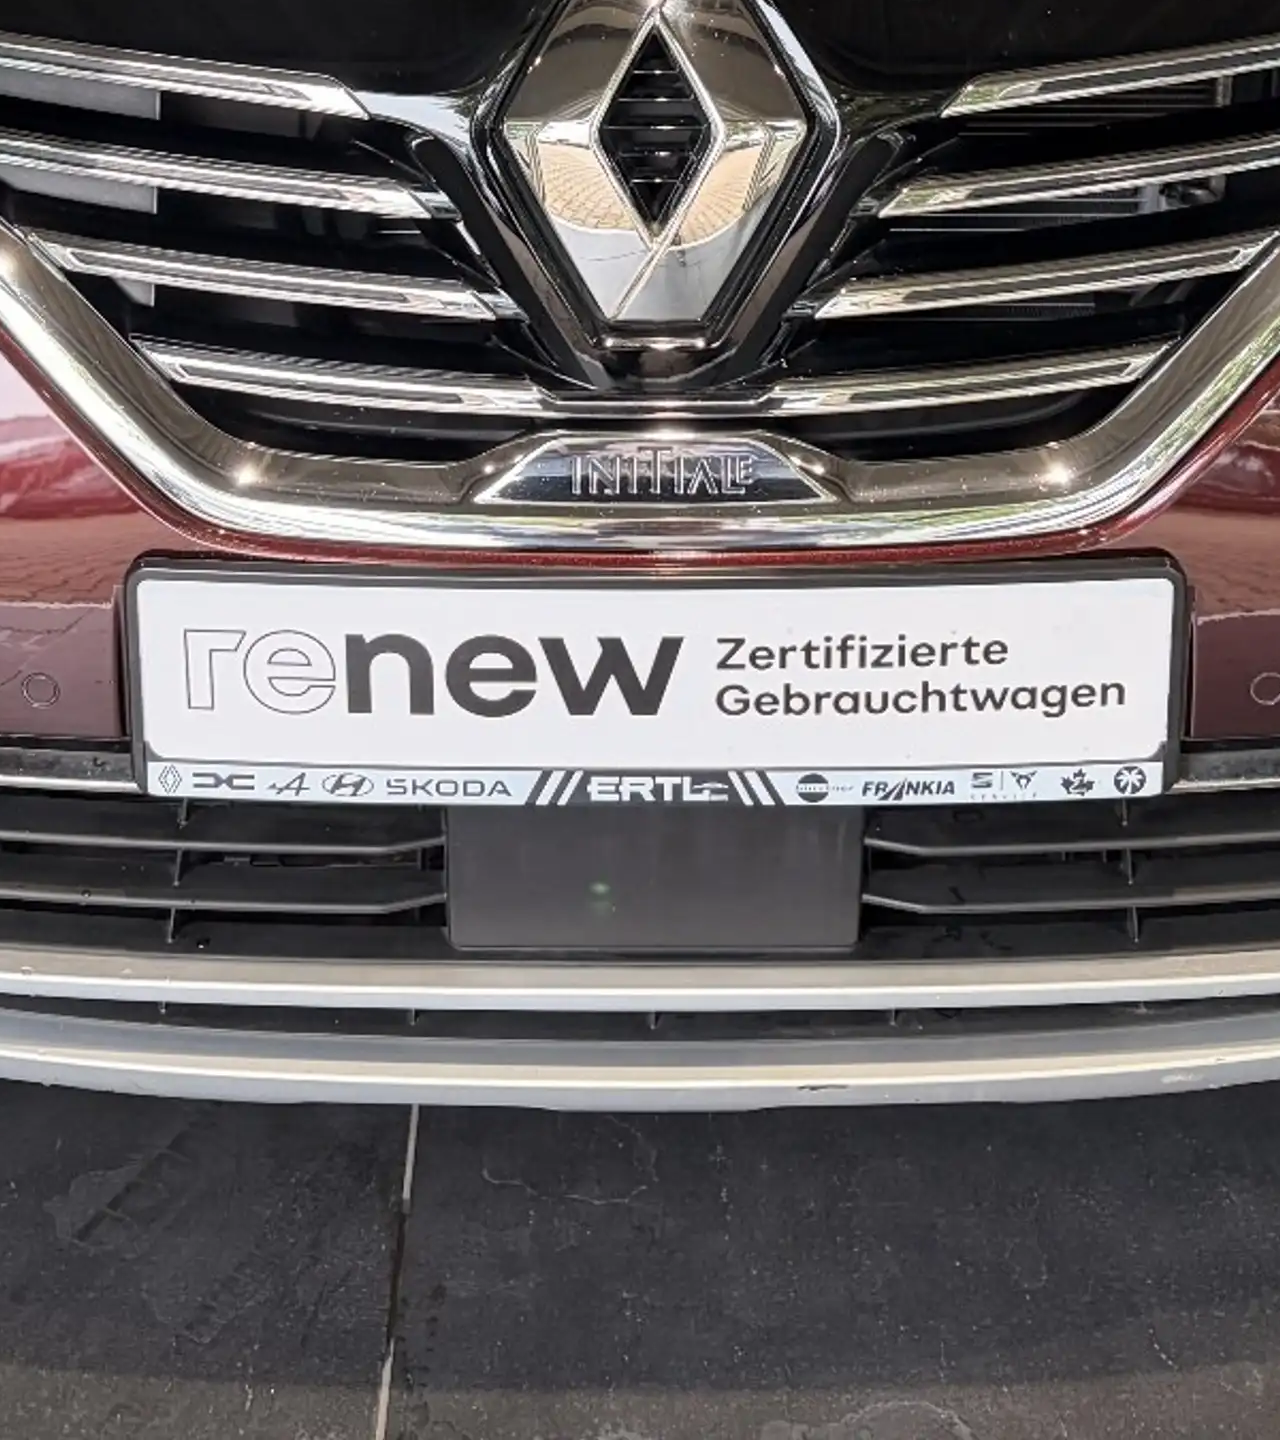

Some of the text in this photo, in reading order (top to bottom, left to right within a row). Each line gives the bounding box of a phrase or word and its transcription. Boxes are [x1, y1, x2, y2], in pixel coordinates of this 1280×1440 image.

[715, 634, 1009, 670] Zertifizierte
[183, 629, 685, 718] renew
[715, 681, 1126, 719] Gebrauchtwagen
[861, 777, 956, 801] FRANKIA
